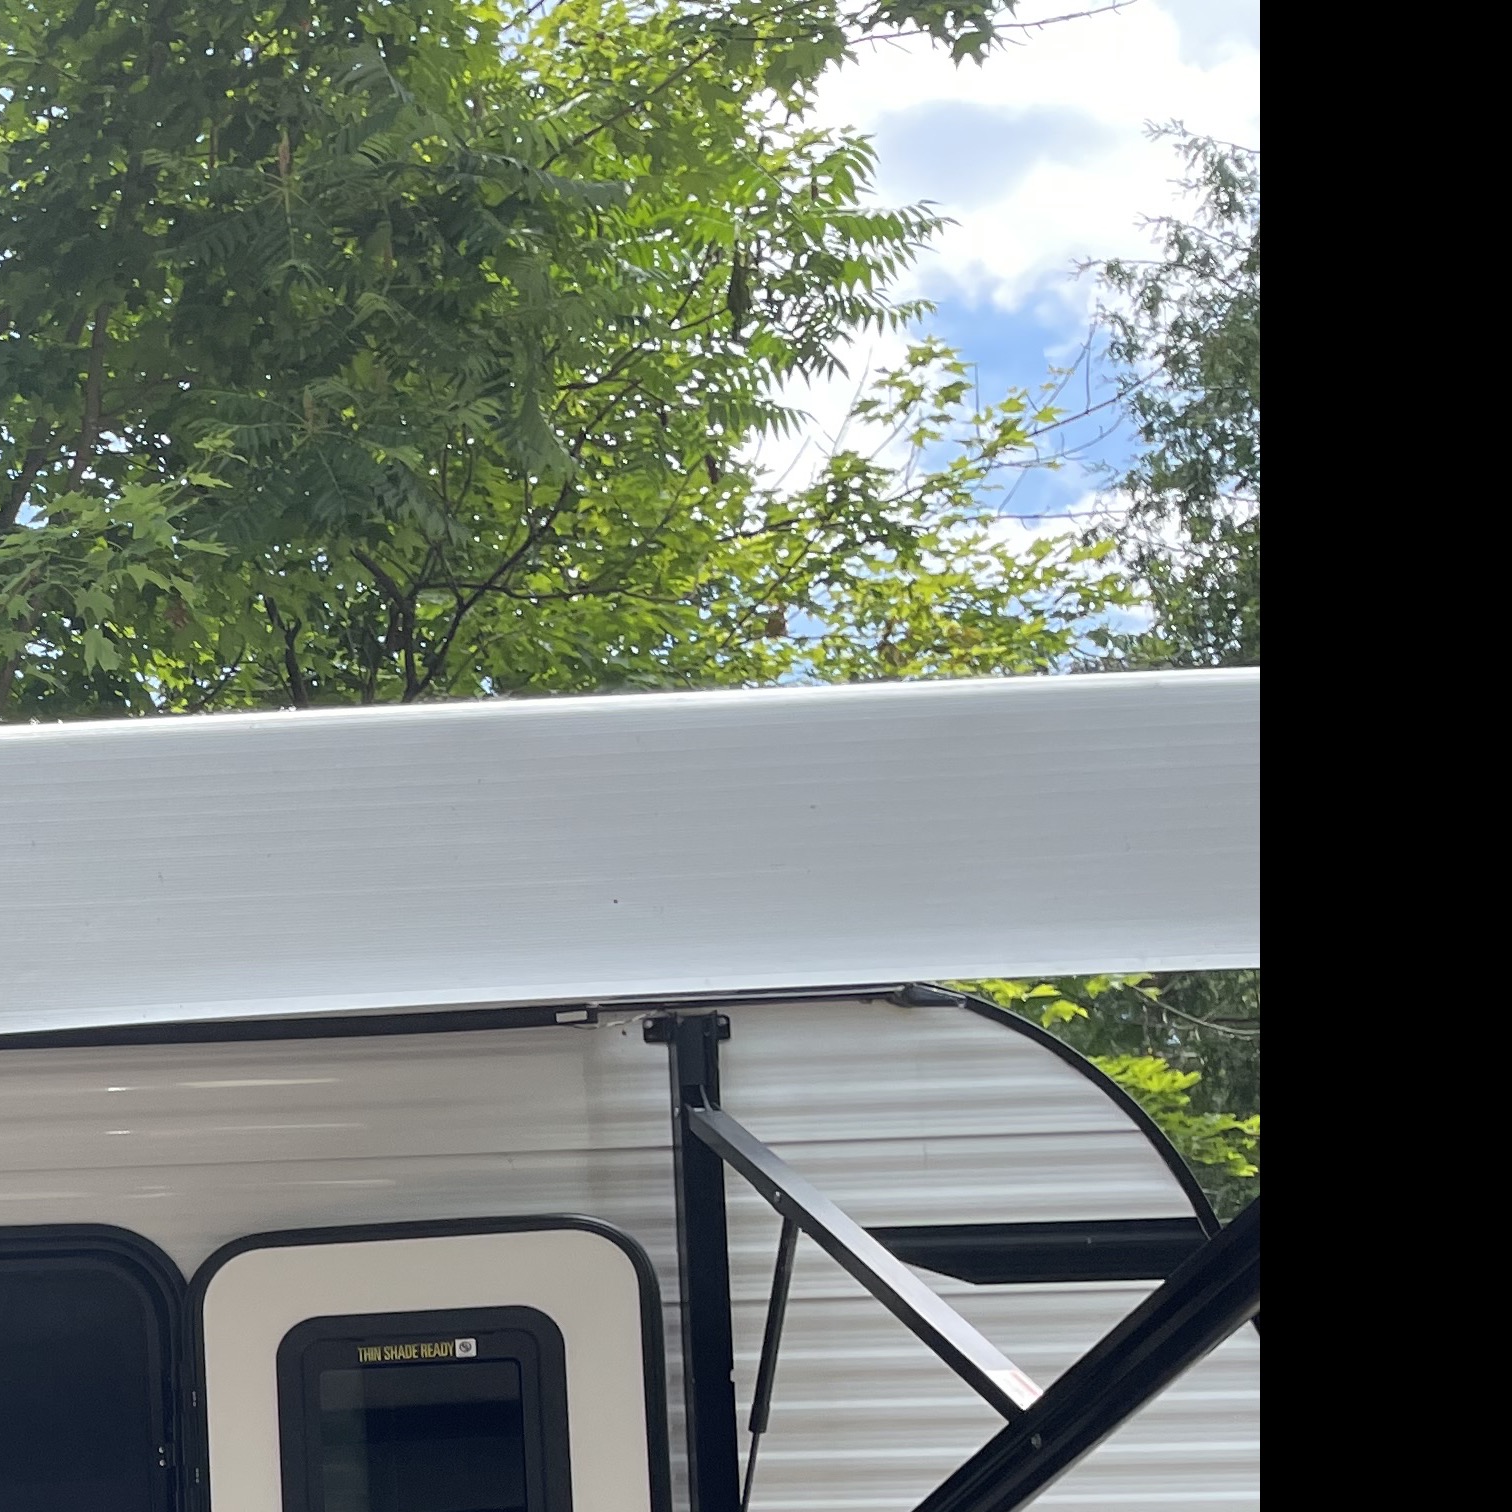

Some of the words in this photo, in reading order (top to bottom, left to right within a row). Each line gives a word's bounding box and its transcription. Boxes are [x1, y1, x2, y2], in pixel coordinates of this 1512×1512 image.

[357, 1347, 382, 1363] THIN
[383, 1345, 419, 1361] SHADE
[420, 1342, 455, 1358] READY
